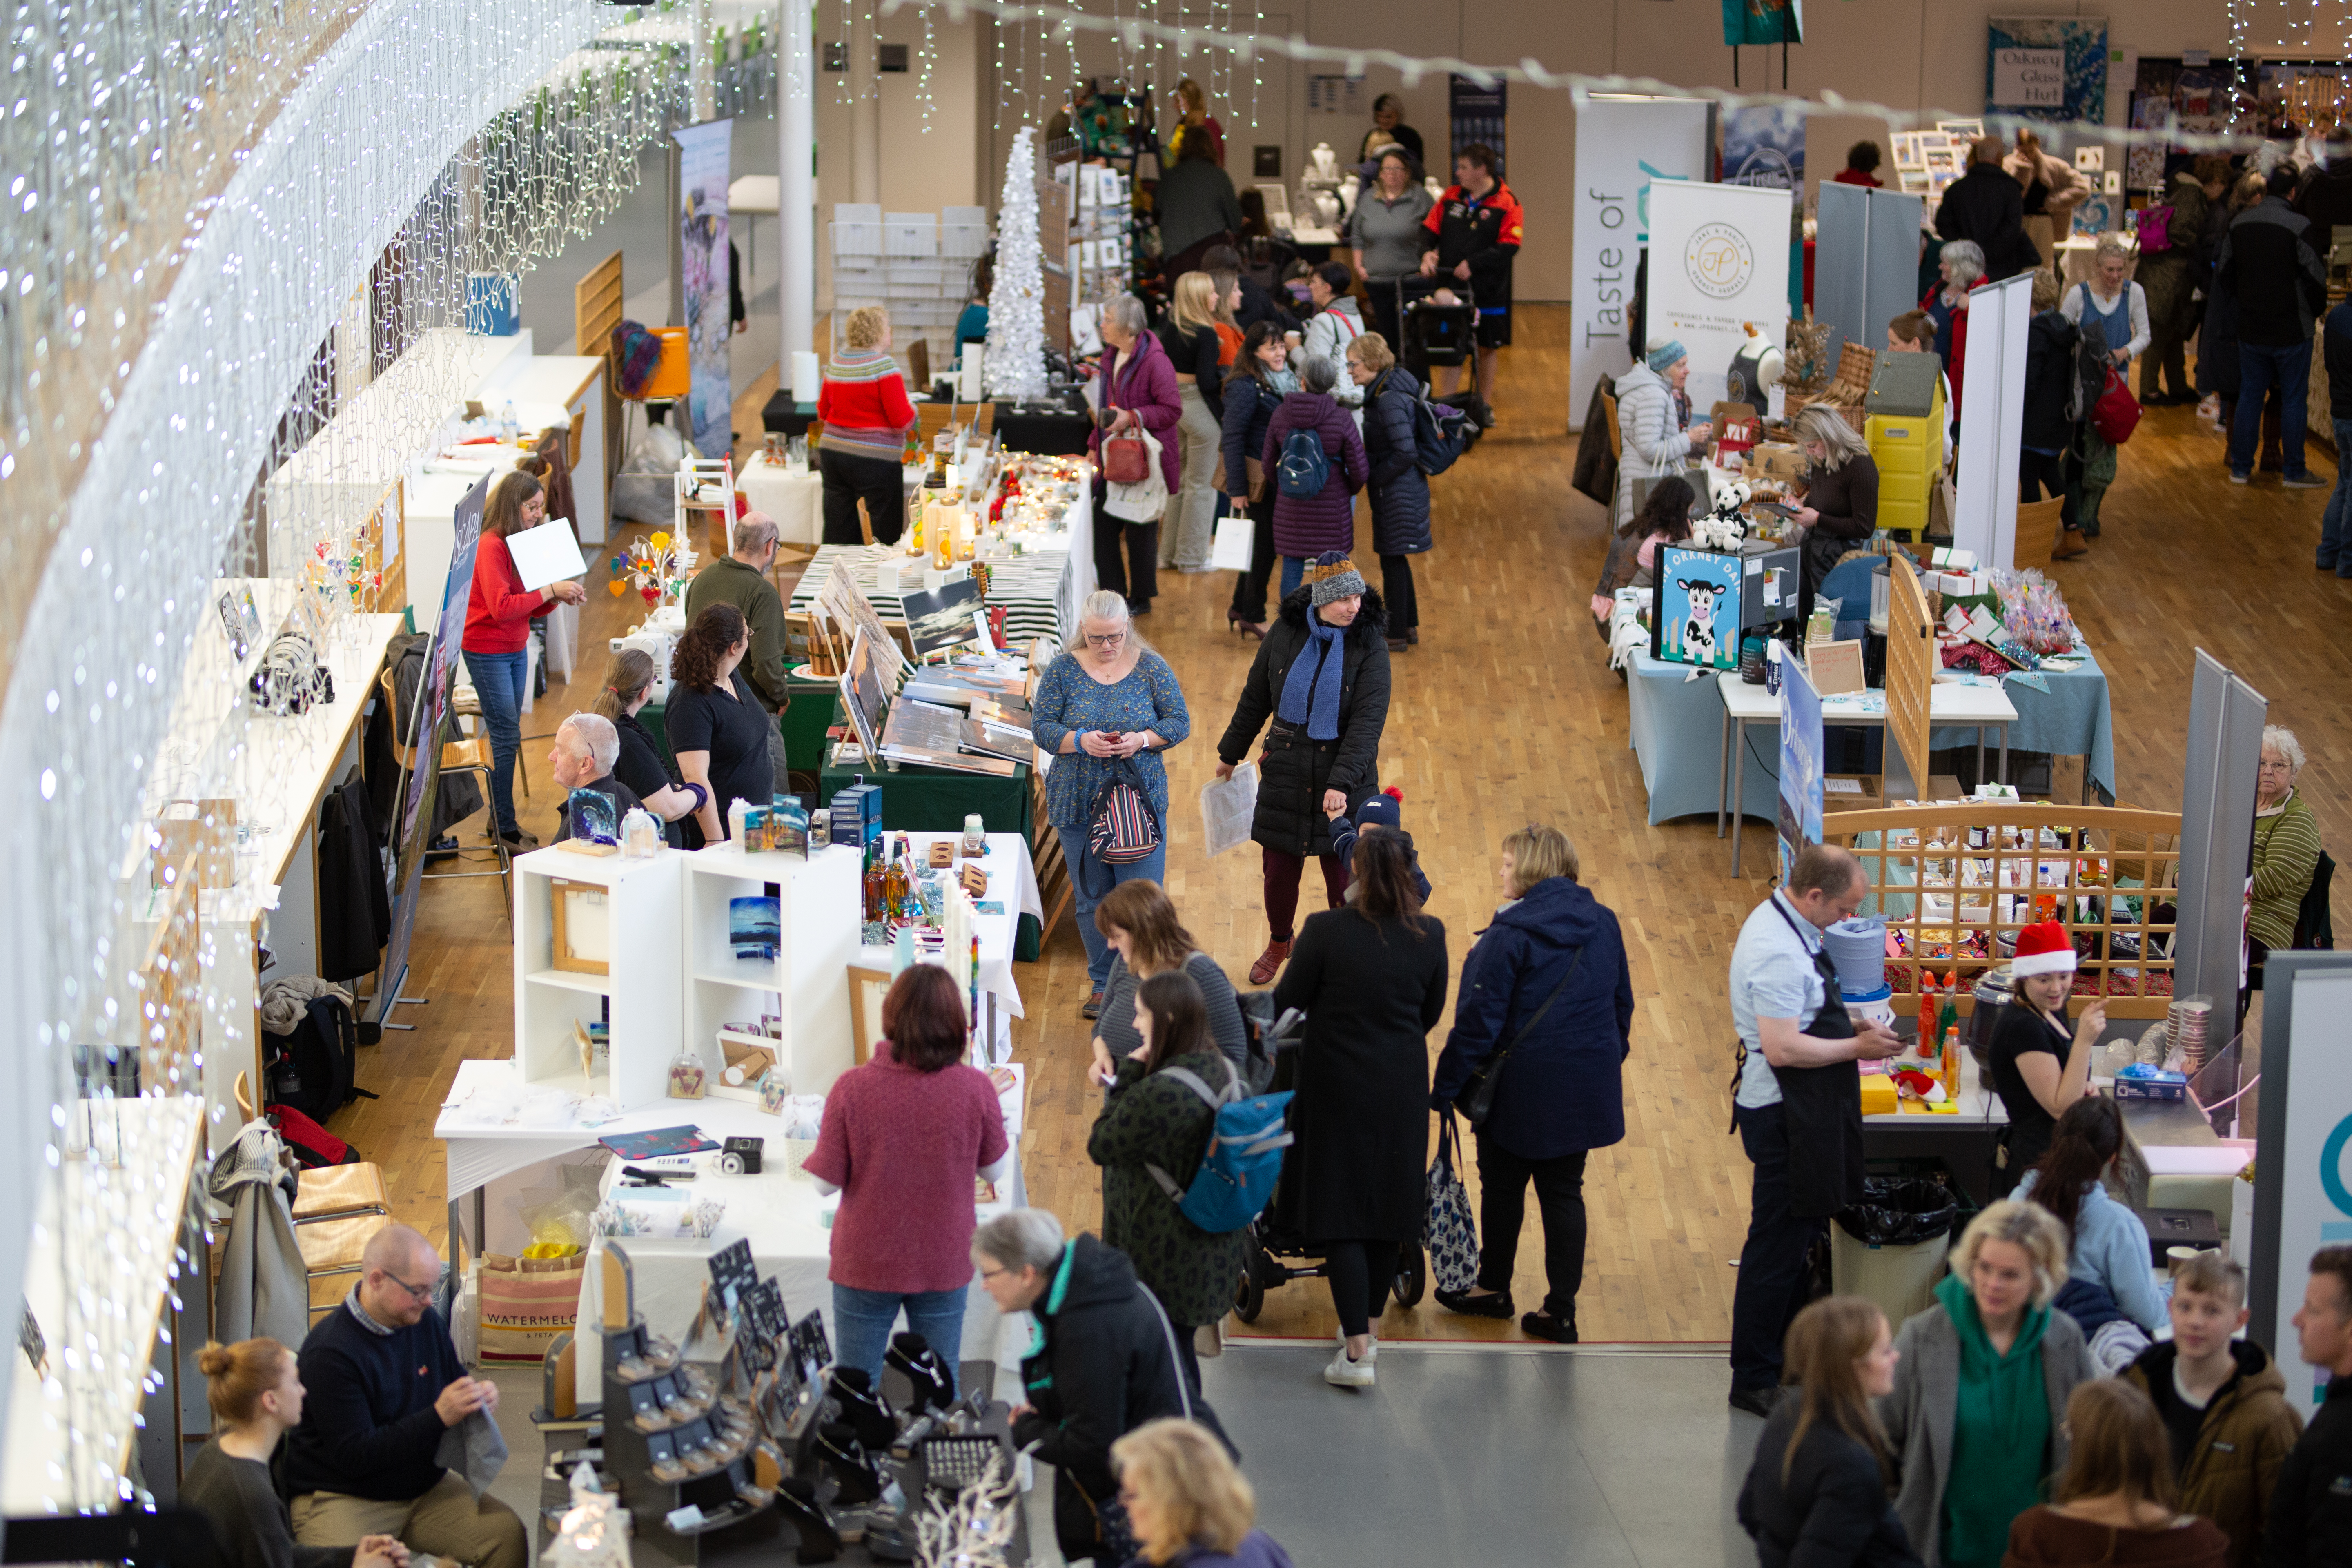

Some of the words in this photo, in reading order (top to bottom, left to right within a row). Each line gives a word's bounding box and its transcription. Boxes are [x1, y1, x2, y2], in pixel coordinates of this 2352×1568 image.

[2003, 51, 2059, 67] Orkney
[2021, 69, 2059, 82] Glass
[2025, 87, 2058, 101] Hut
[1590, 188, 1624, 229] of
[1586, 247, 1623, 348] Taste
[454, 509, 480, 563] SCAPA
[1673, 550, 1721, 565] ORKNEY
[488, 1313, 577, 1325] WATERMELO
